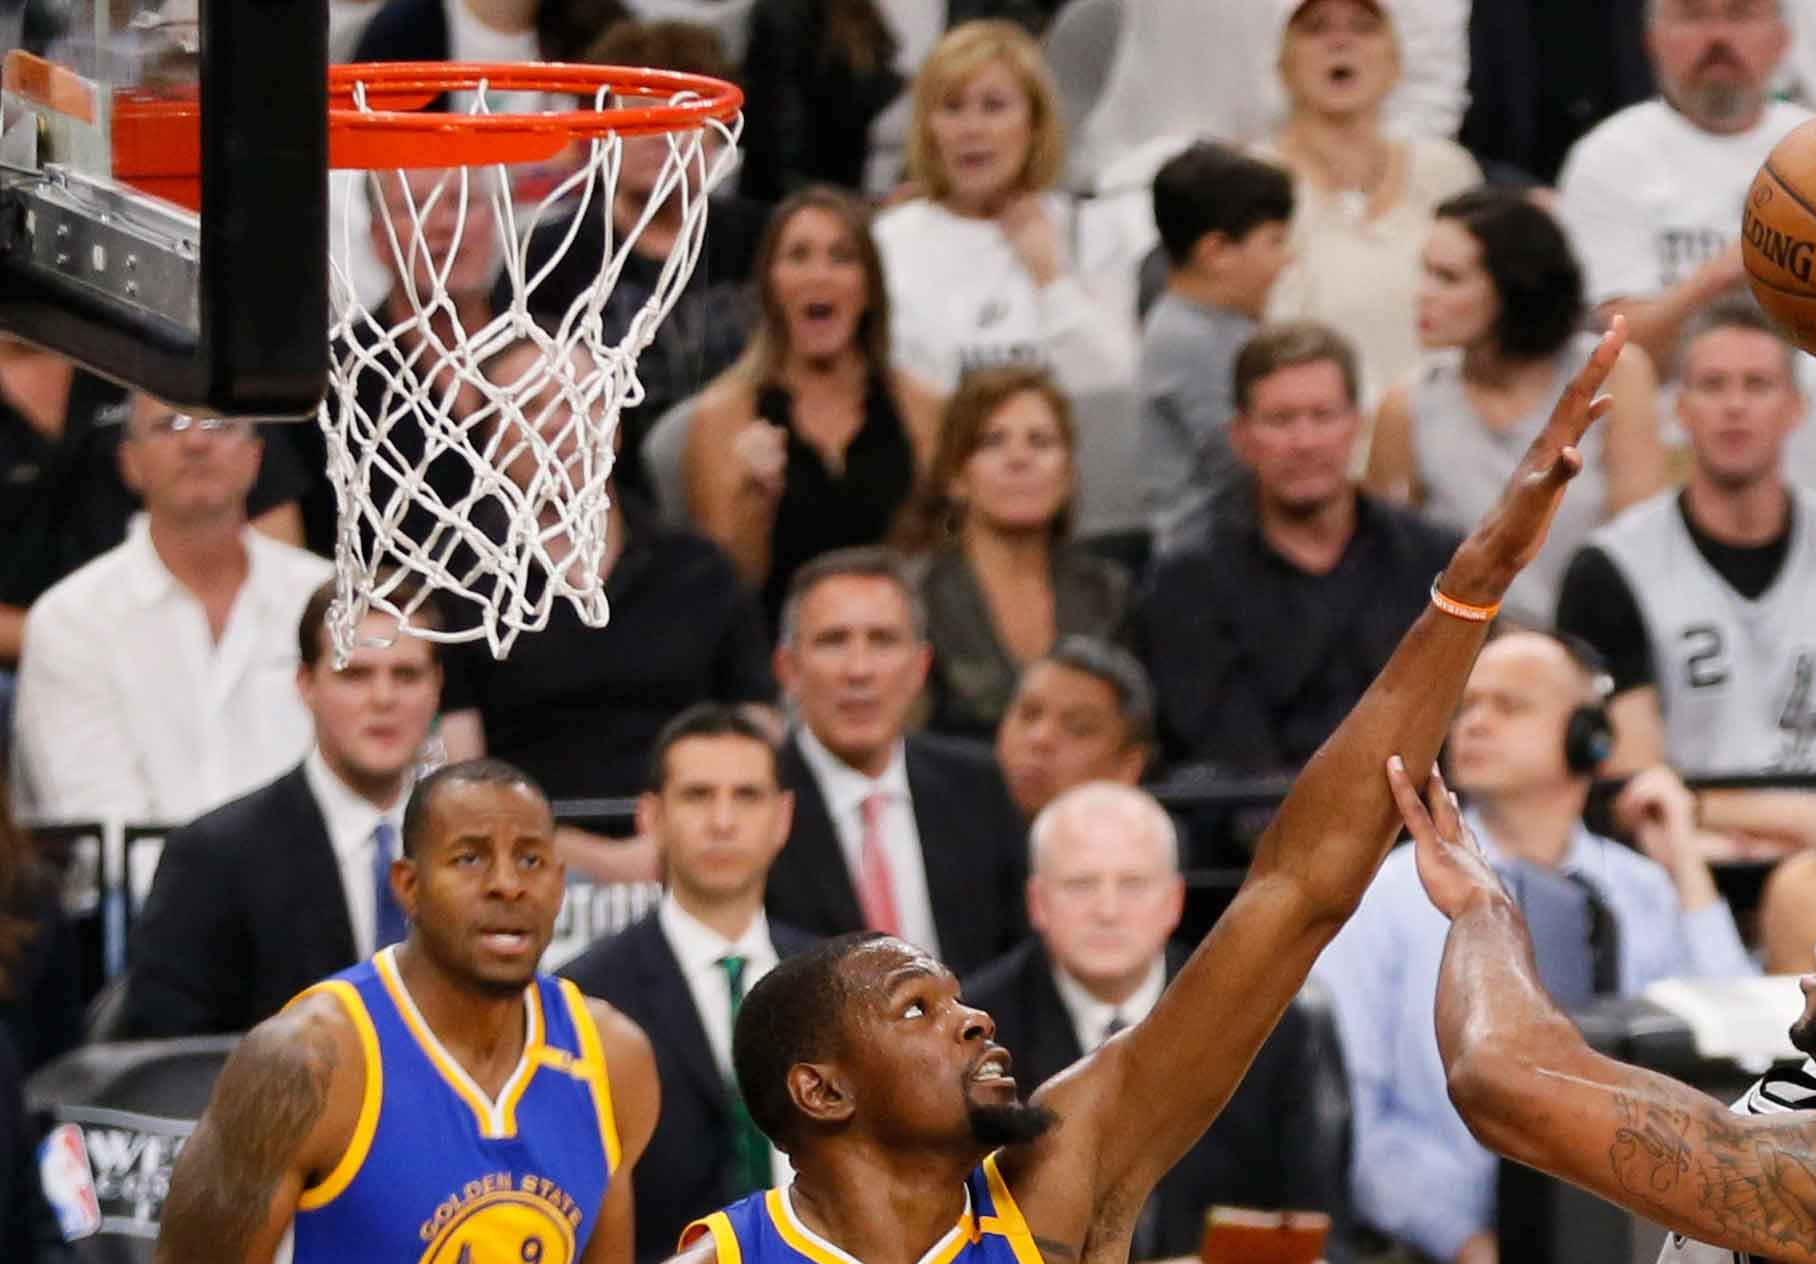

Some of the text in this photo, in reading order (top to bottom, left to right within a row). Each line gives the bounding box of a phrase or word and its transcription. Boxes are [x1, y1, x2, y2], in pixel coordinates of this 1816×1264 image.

[1683, 622, 1728, 690] 2
[419, 1170, 584, 1241] GOLDEN STATE
